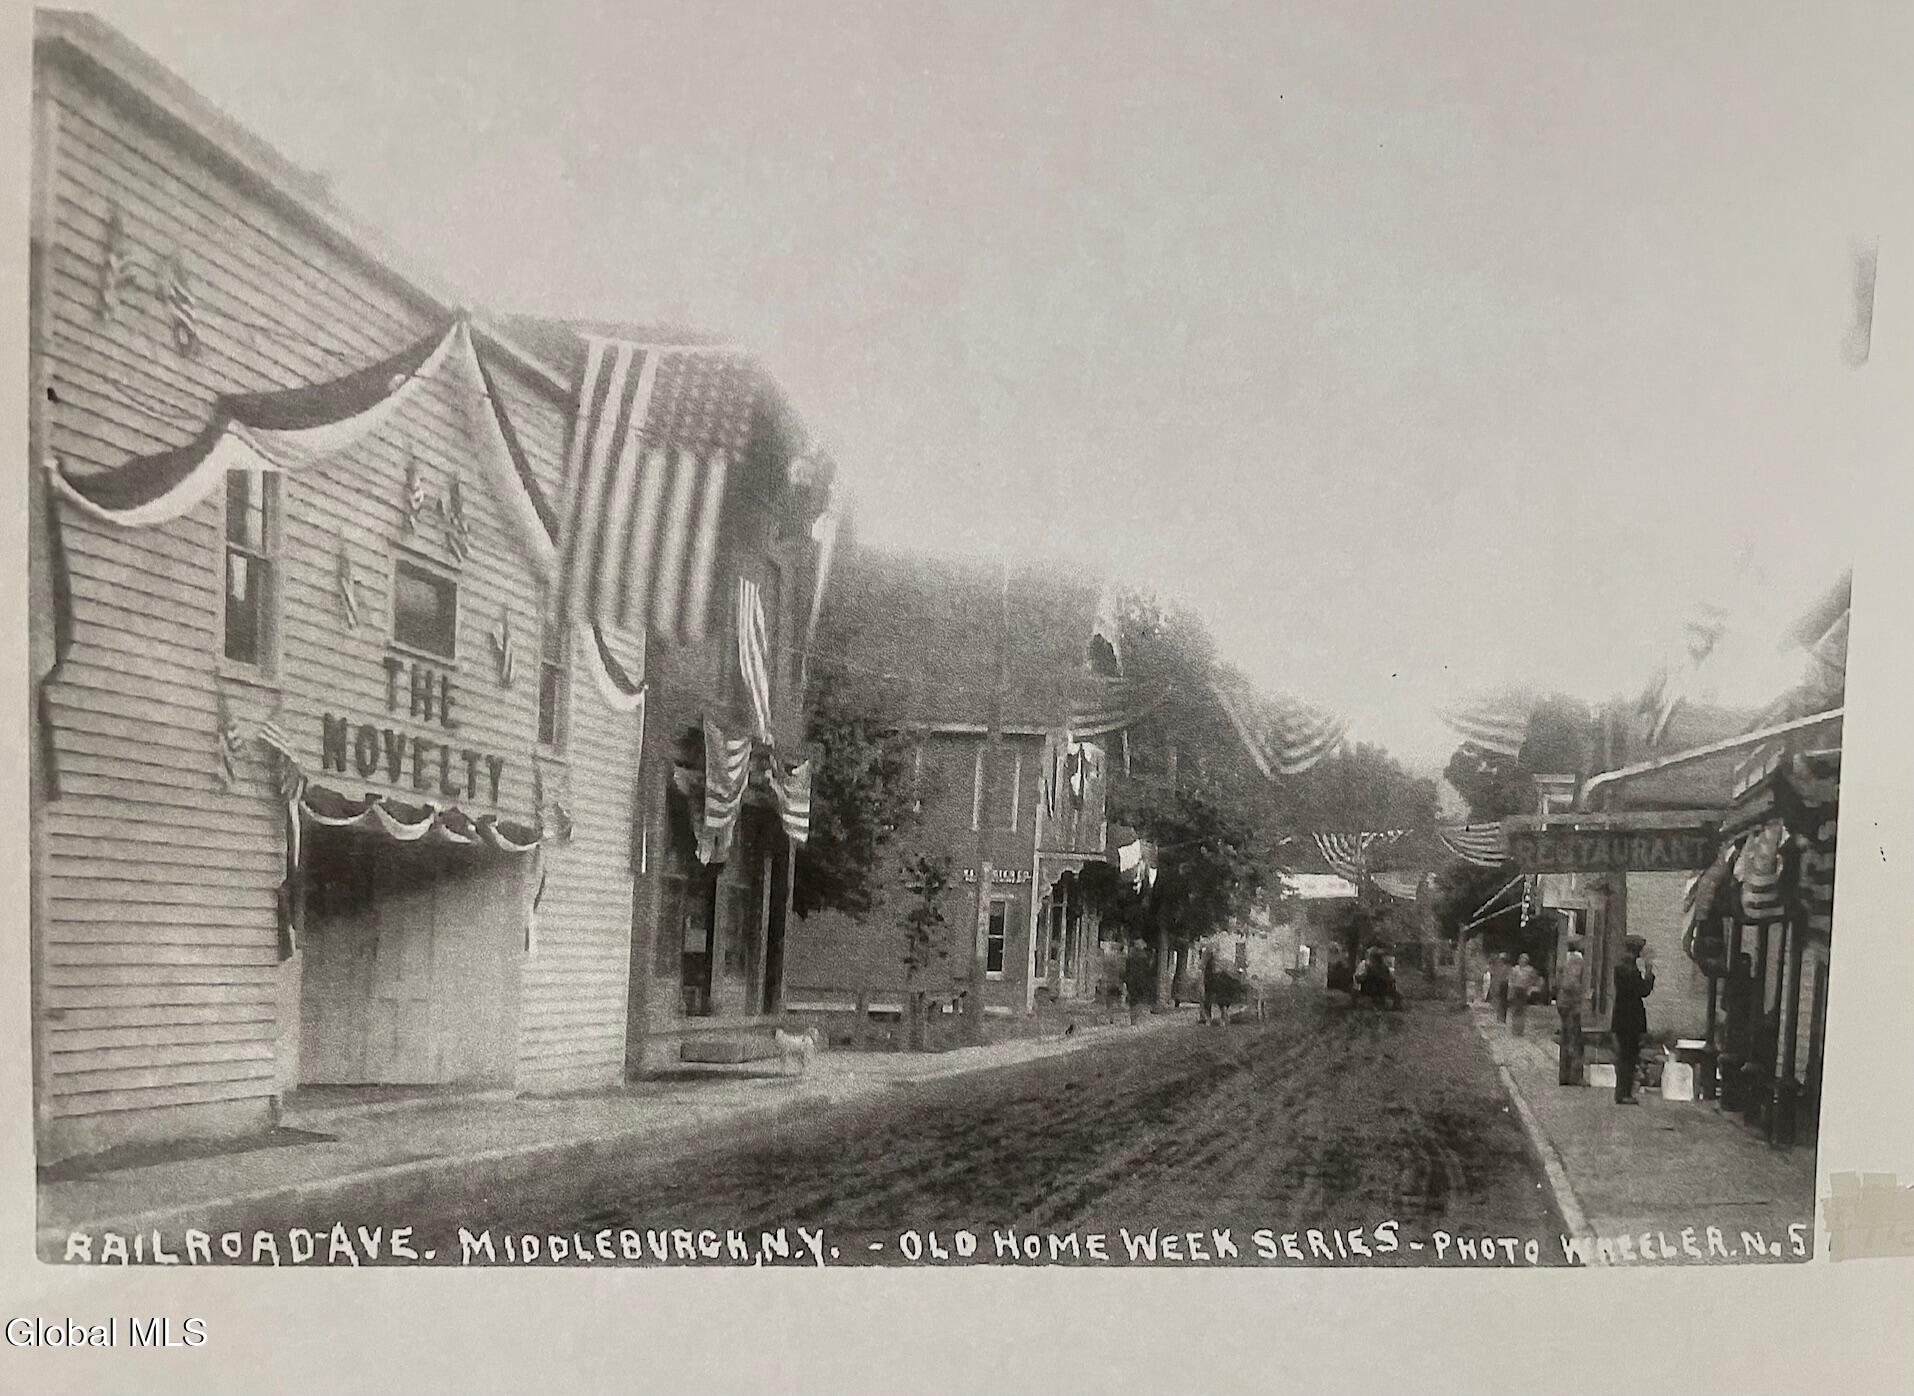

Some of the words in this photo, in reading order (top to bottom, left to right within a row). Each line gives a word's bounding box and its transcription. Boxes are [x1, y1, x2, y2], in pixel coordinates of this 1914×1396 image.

[383, 656, 457, 729] THE
[322, 712, 503, 803] NOVELTY
[1514, 834, 1709, 867] RESTAURANT
